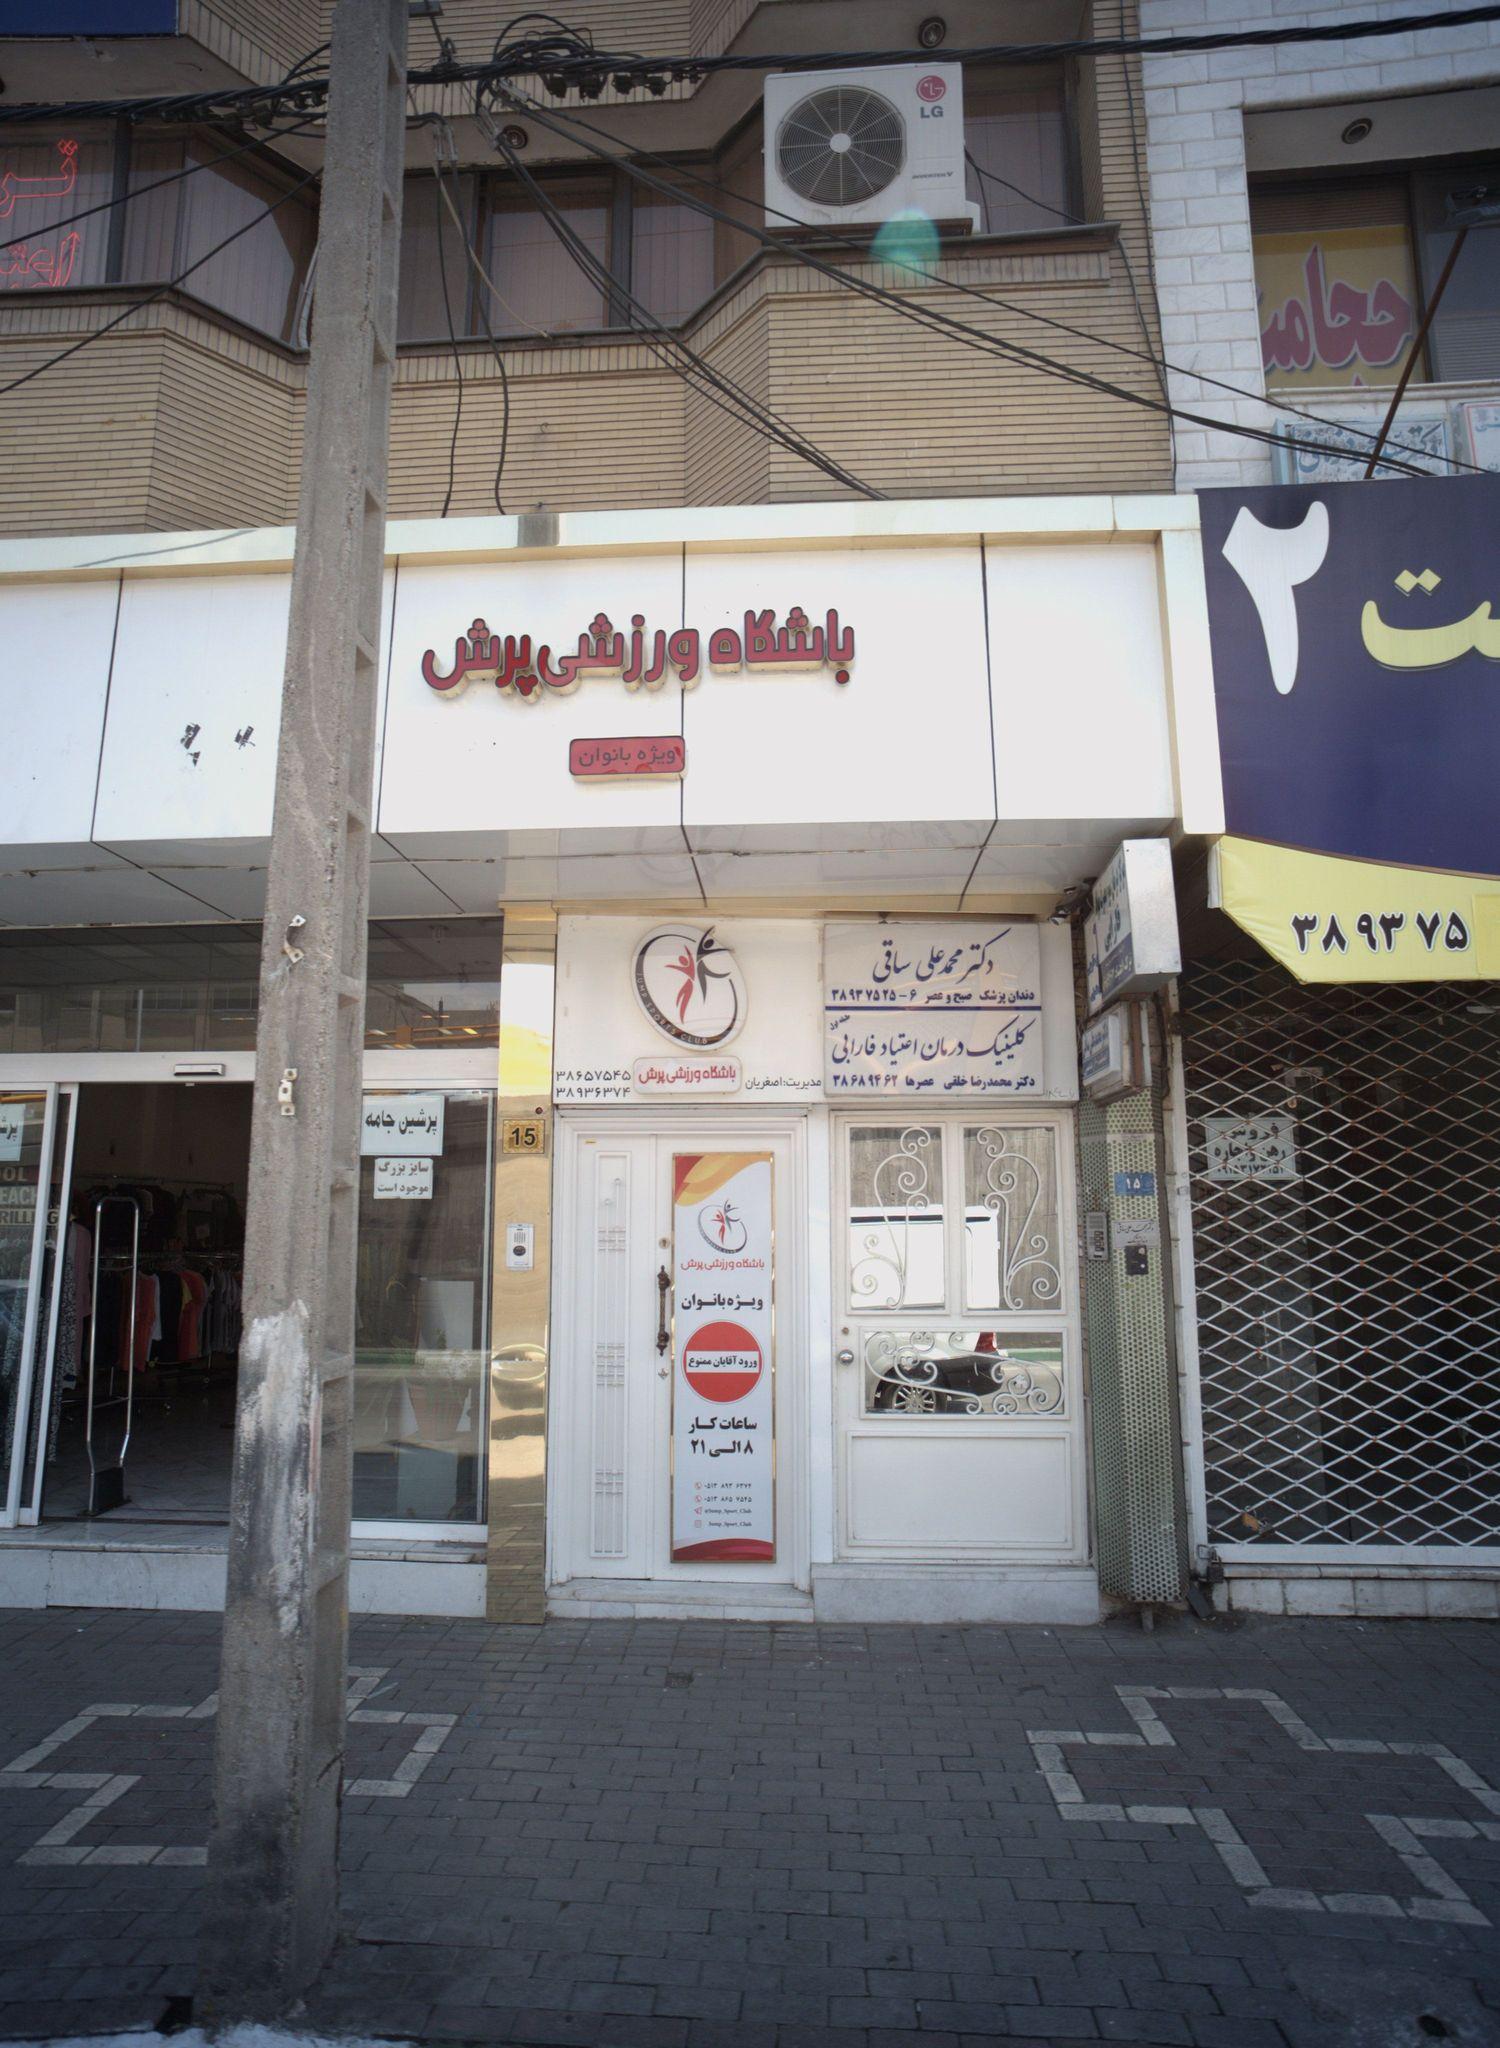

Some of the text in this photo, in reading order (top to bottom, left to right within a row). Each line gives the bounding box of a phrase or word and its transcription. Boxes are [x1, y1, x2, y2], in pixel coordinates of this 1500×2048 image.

[920, 105, 944, 119] LG
[1221, 500, 1331, 696] ۲
[421, 606, 855, 698] باشگاه ورزشی پرش
[578, 745, 676, 767] ویژه بانوان
[872, 939, 912, 984] ساقی
[956, 927, 1012, 985] دکتر
[925, 992, 943, 1004] عصر
[945, 994, 952, 1005] و
[953, 992, 973, 1005] صبح
[979, 990, 1006, 1004] پزشک
[680, 1032, 709, 1046] CLUB
[832, 1015, 1037, 1066] کلینیک درمان اعتیاد فارابی
[555, 1069, 632, 1082] ۳۸۶۵۷۵۴۵
[638, 1065, 737, 1084] باشگاه ورزشی پرش
[905, 1077, 935, 1090] عصرها
[970, 1076, 1013, 1090] محمدرضا
[1014, 1077, 1036, 1090] دکتر
[555, 1086, 631, 1099] ۳۸۹۳۶۳۷۴
[365, 1108, 438, 1136] پرشین جامه
[511, 1127, 536, 1146] 15
[0, 1166, 28, 1182] OL
[378, 1161, 430, 1177] سایز بزرگ
[377, 1183, 430, 1196] موجود است
[1126, 1178, 1141, 1190] ۱۵
[680, 1258, 765, 1271] باشگاه ورزشی پرش
[681, 1293, 764, 1311] ویژه بانوان
[687, 1355, 758, 1369] ورود آقایان ممنوع
[687, 1416, 758, 1434] ساعات کار
[690, 1438, 754, 1458] ۸ الی ۲۱
